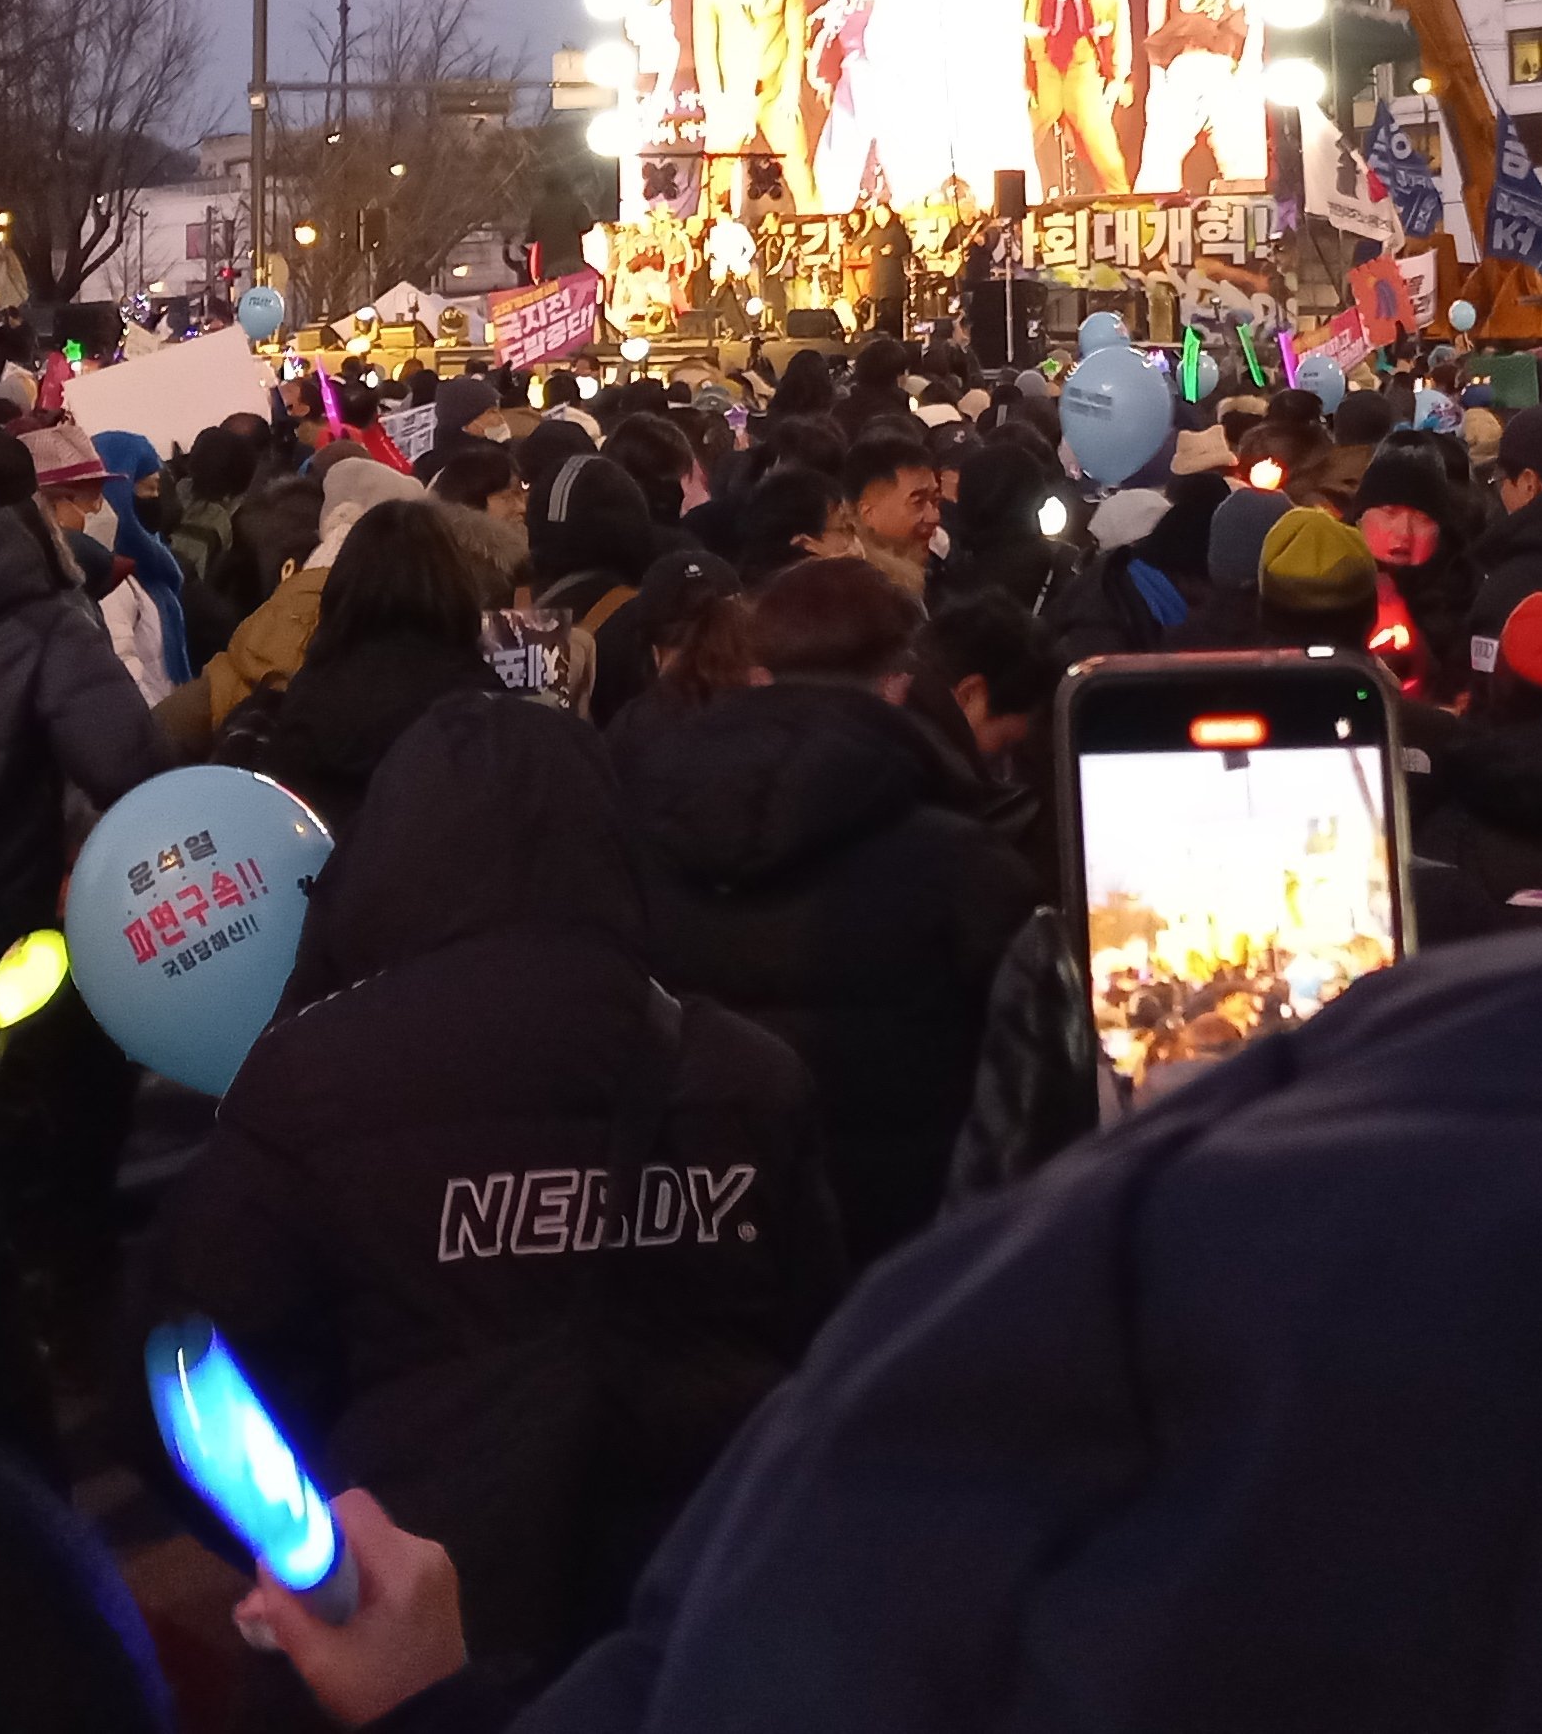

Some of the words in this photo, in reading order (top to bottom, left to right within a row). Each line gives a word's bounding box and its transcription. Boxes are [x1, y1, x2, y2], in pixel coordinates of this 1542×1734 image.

[493, 287, 572, 342] 국지전
[127, 829, 218, 896] 윤석열
[122, 857, 270, 965] 파면구속!!
[161, 913, 261, 979] 국힘당해산!!
